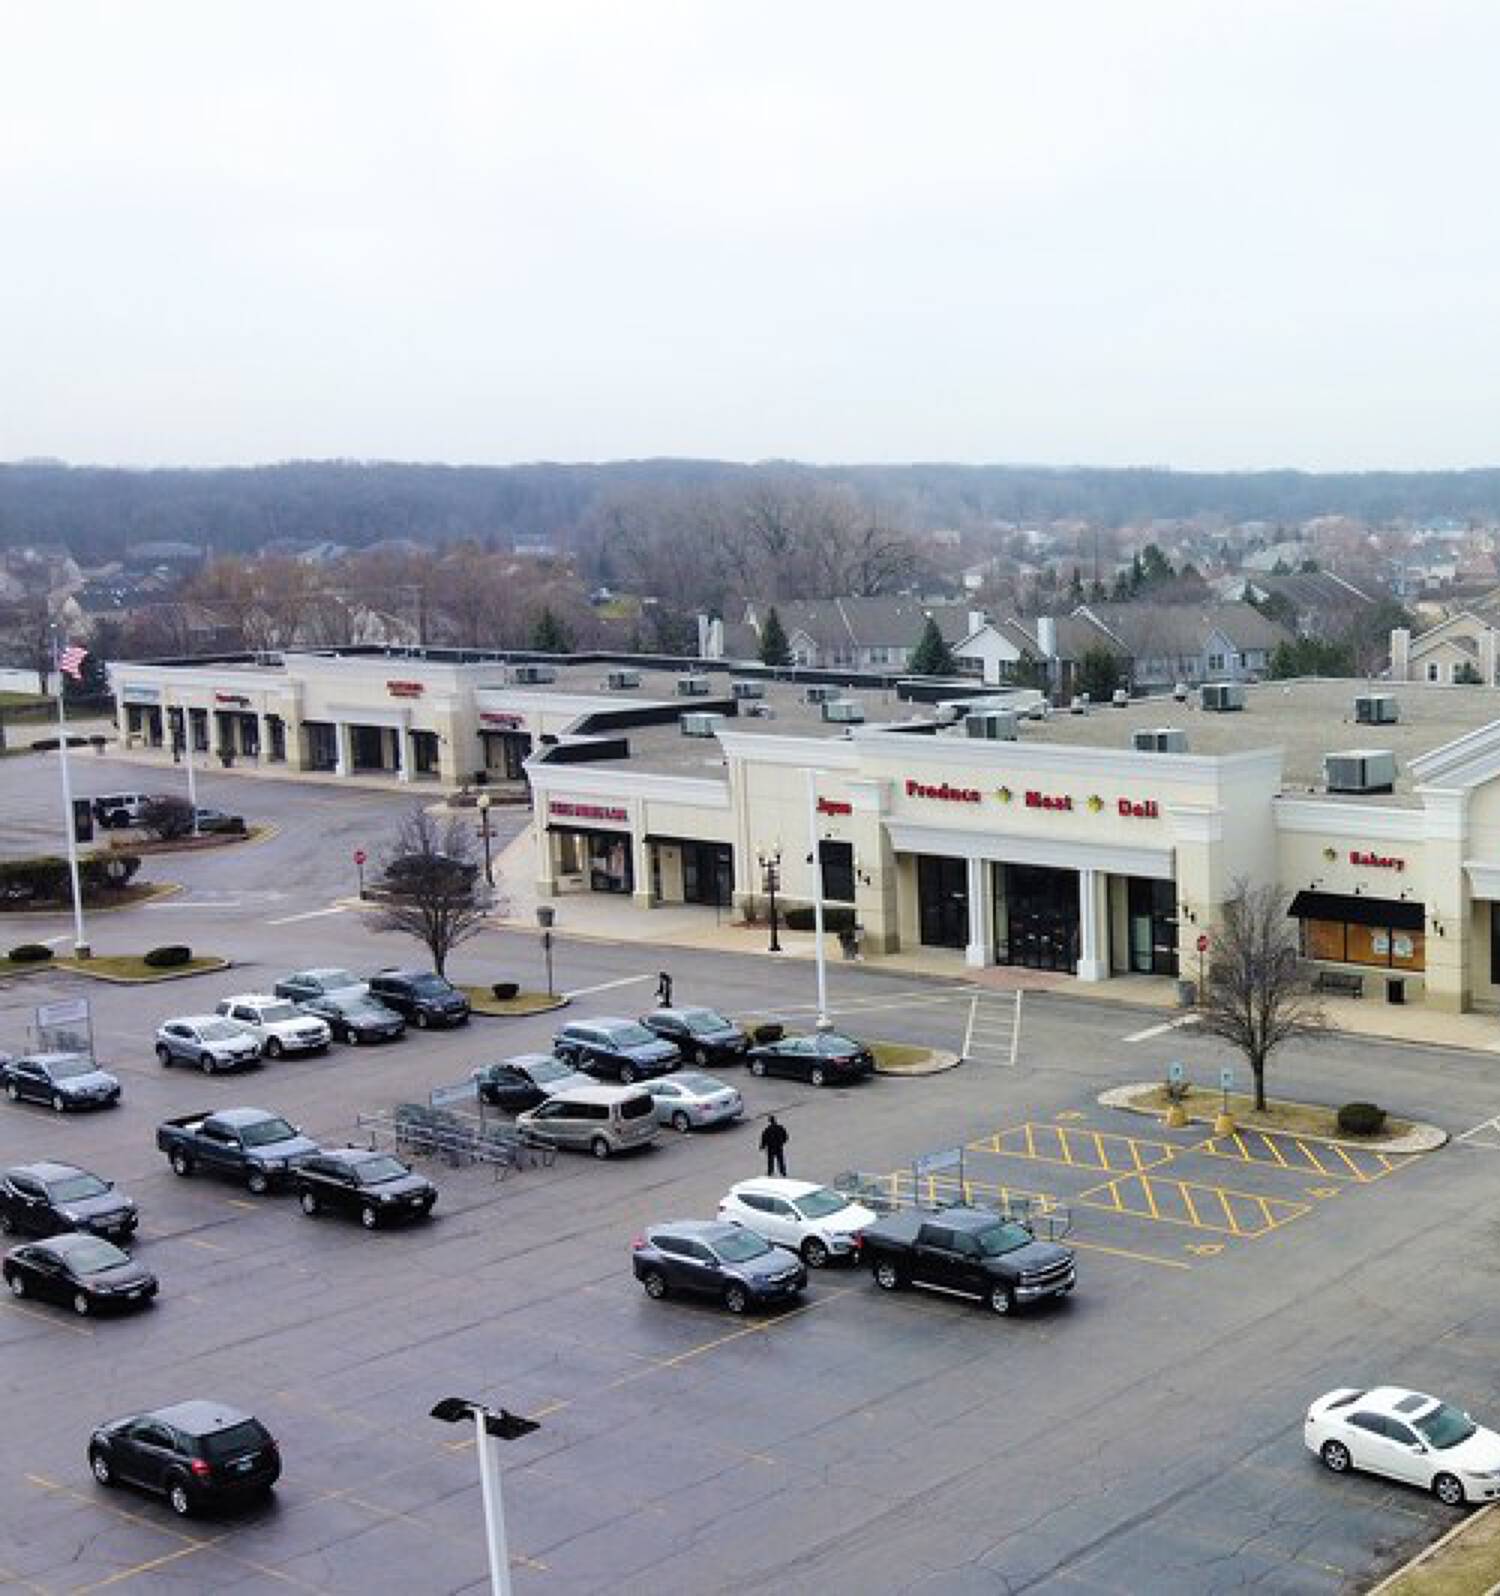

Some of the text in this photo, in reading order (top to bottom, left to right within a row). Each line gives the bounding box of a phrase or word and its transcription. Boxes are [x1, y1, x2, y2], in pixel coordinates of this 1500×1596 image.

[905, 780, 1159, 818] Produce Meat Deli
[1349, 851, 1405, 872] Bakery
